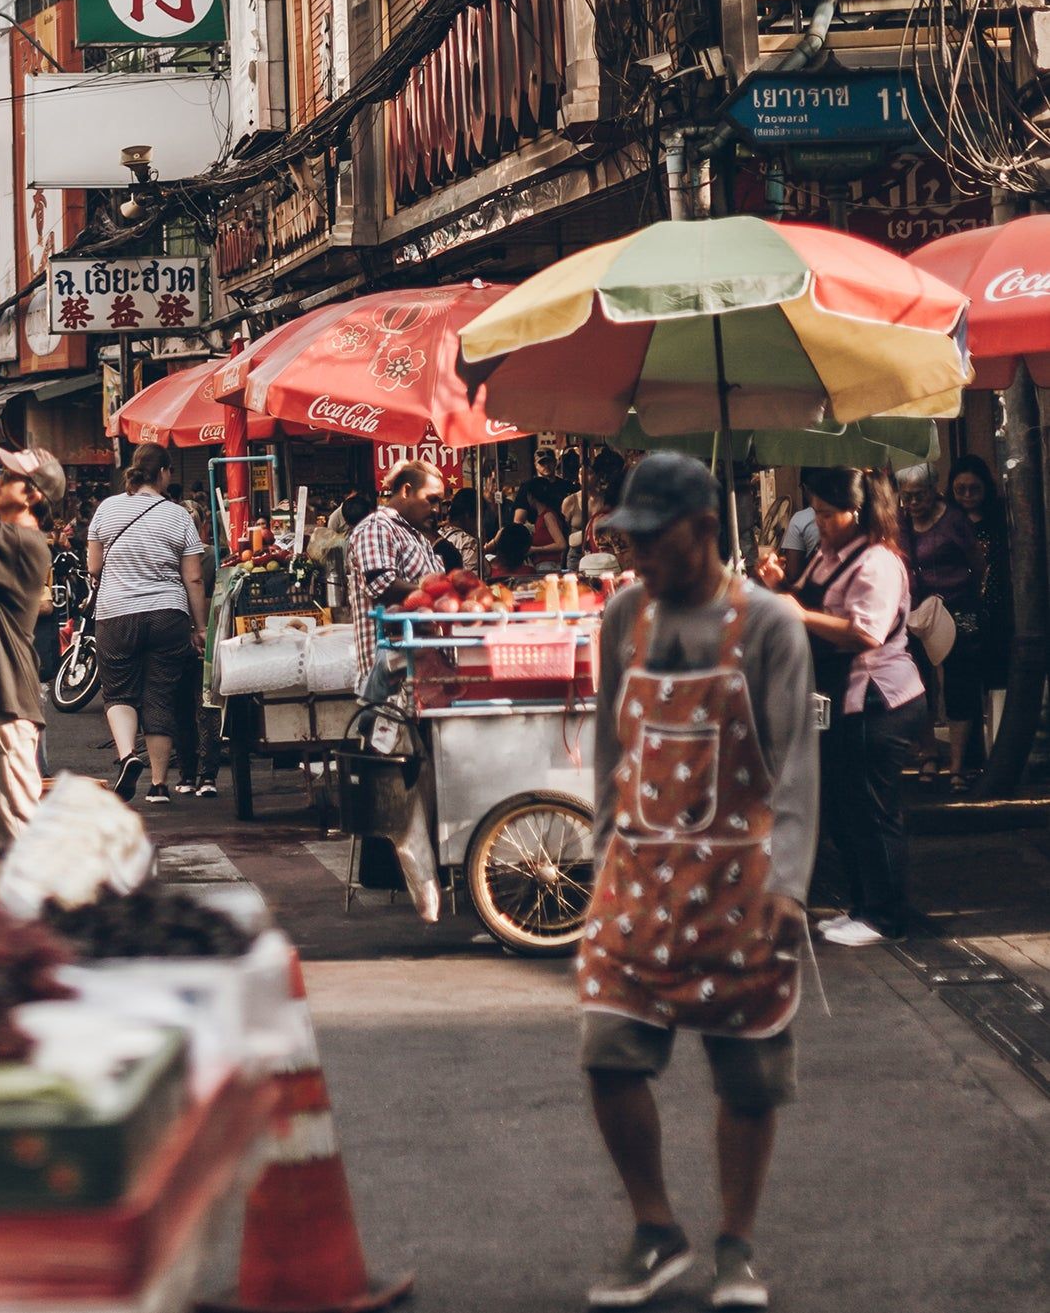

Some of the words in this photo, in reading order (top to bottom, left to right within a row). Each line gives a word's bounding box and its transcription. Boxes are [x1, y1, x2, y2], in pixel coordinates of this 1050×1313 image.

[753, 85, 850, 109] เยาวราช
[877, 87, 909, 122] 11
[757, 114, 808, 124] Yaowarat
[887, 218, 992, 240] เยาวรา
[58, 294, 194, 329] 蔡益發
[307, 394, 385, 434] Coca-Cola
